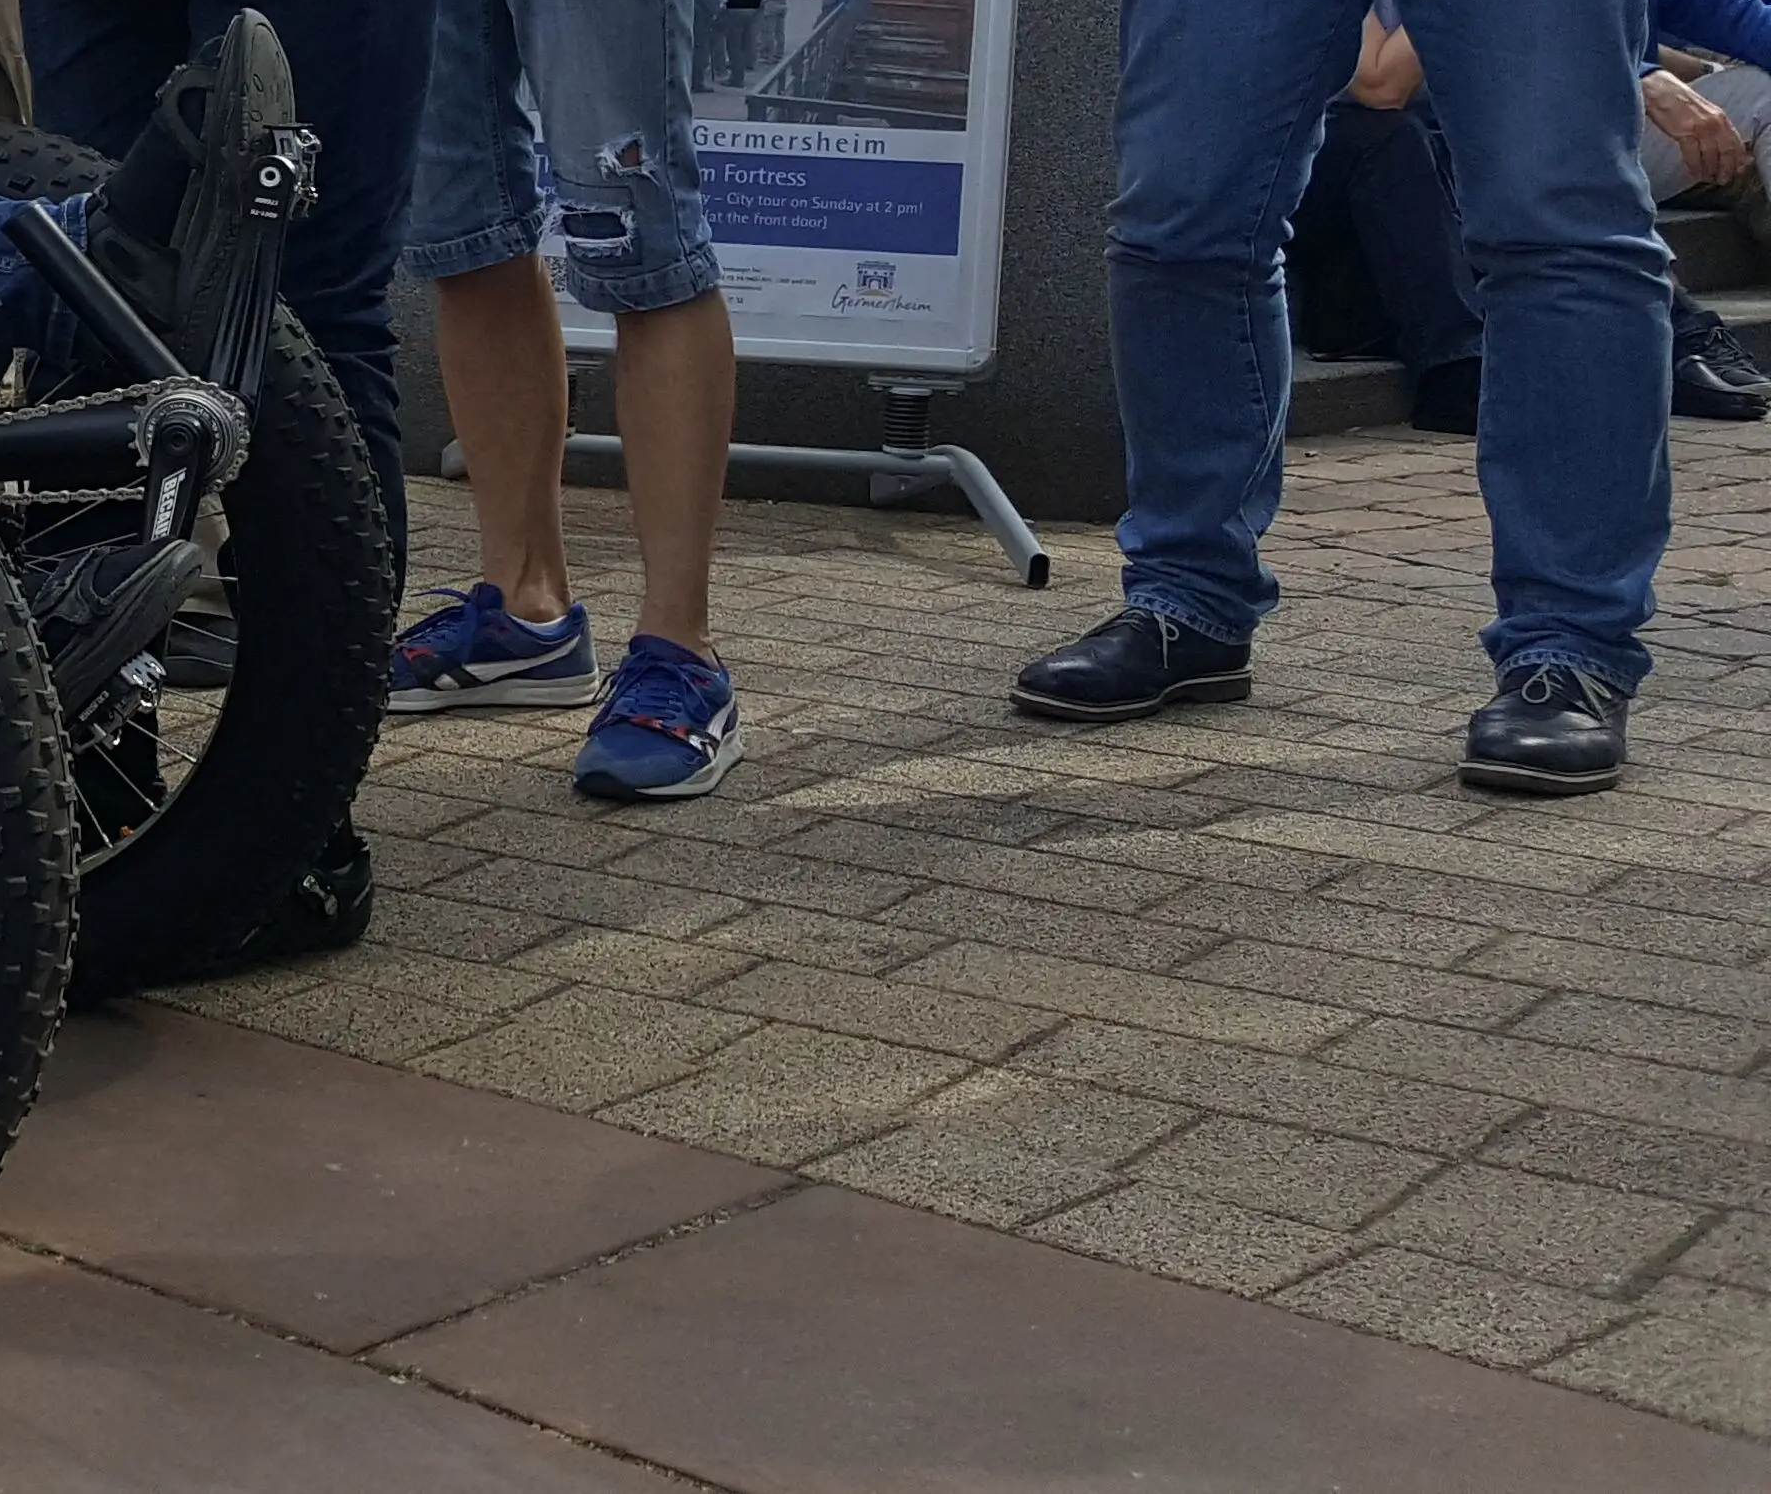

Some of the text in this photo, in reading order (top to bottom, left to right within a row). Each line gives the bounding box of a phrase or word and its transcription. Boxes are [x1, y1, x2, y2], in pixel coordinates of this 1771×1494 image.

[693, 124, 886, 155] Germersheim
[724, 163, 807, 187] Fortress
[726, 192, 754, 208] City
[759, 195, 787, 207] tour
[791, 198, 808, 209] on
[811, 196, 863, 214] Sunday
[866, 201, 880, 213] at
[884, 200, 893, 213] 2
[727, 211, 750, 224] the
[754, 212, 787, 226] front
[832, 283, 932, 314] Germersheim
